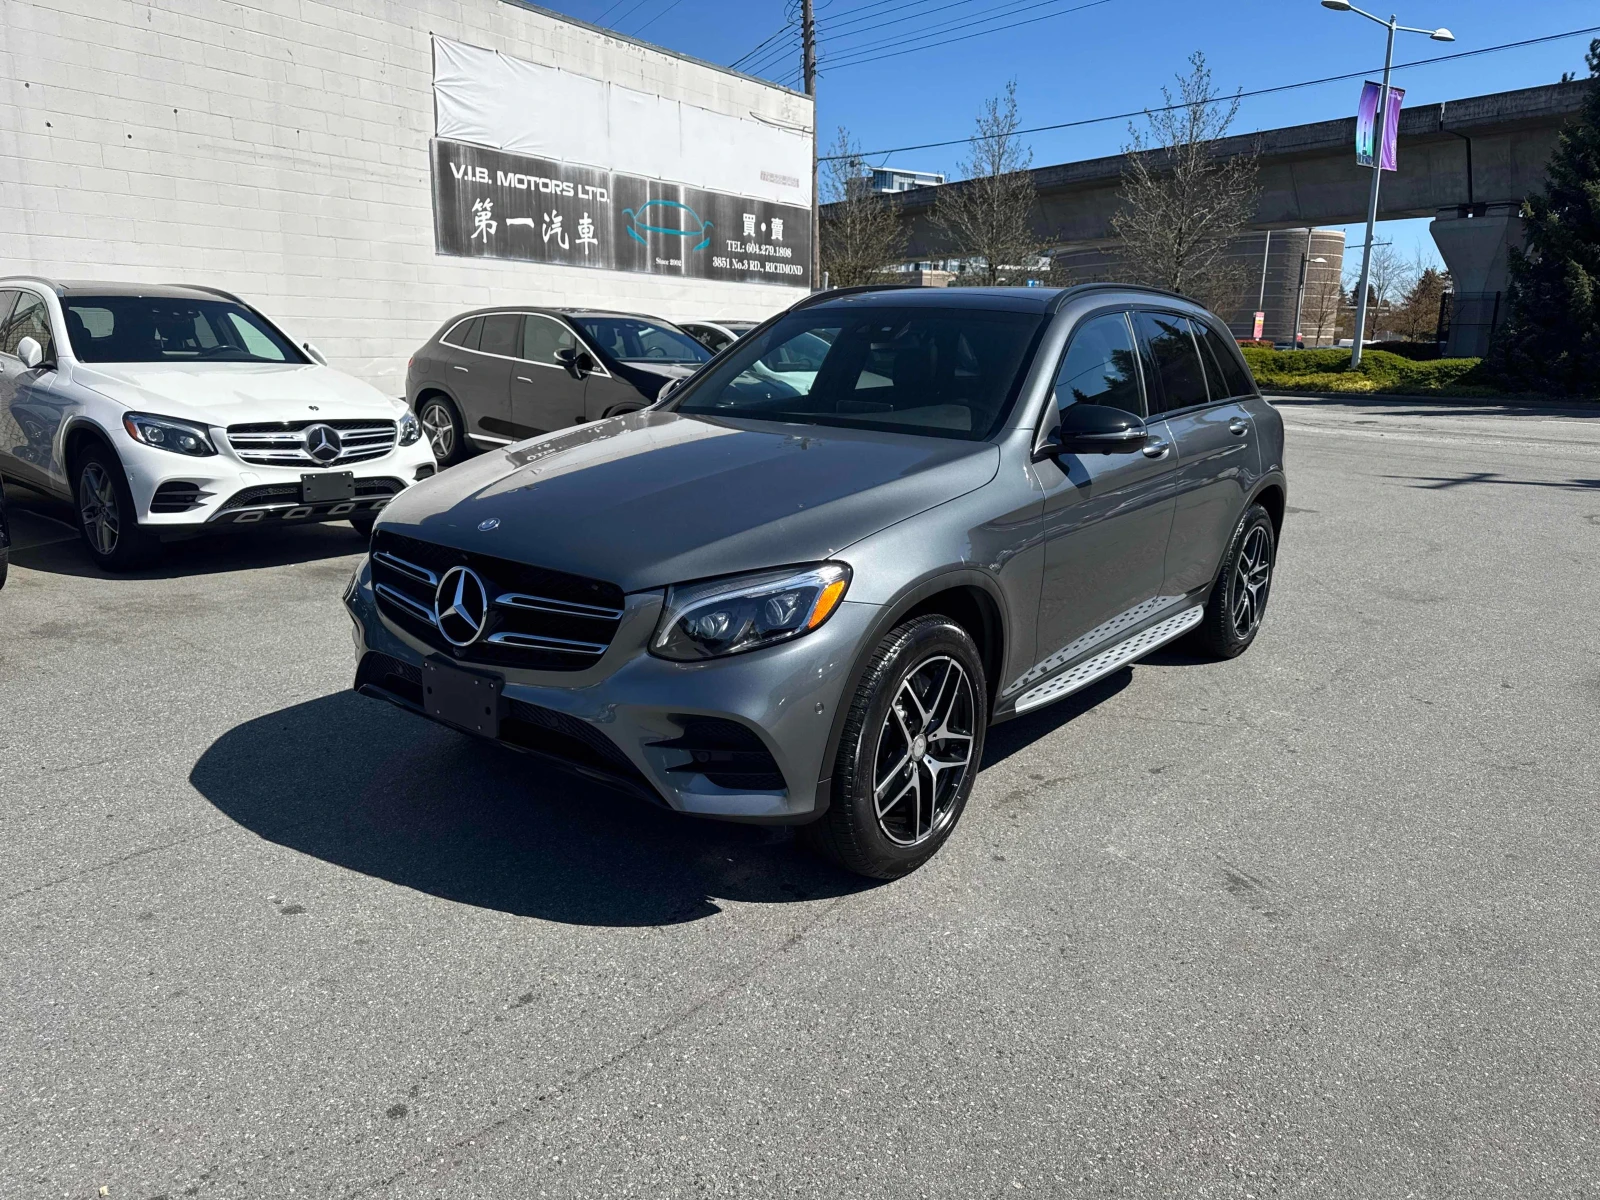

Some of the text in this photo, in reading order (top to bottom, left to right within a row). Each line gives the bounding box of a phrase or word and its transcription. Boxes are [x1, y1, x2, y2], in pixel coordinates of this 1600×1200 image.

[450, 162, 610, 203] V.I.B. MOTORS LTD.
[471, 198, 598, 255] 第一汽車
[726, 240, 792, 258] TEL: 604.279.1898
[712, 256, 730, 269] 3851
[765, 261, 803, 276] RICHMOND
